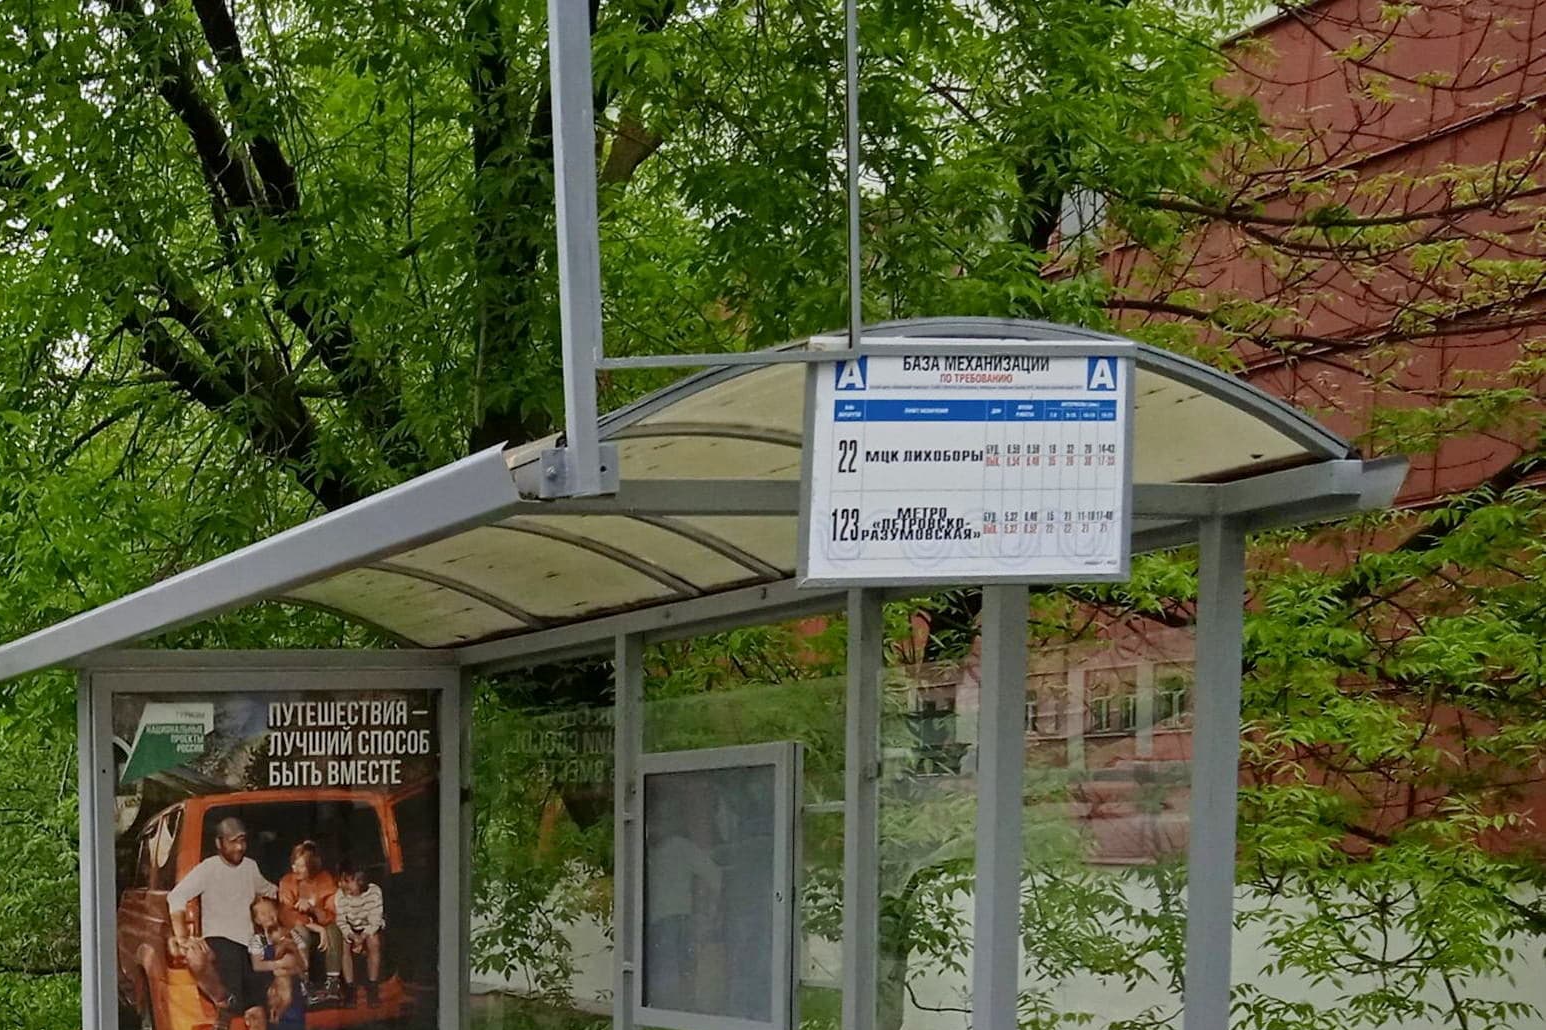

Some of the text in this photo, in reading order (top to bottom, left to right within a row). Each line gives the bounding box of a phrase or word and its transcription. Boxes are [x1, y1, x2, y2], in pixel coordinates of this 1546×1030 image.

[903, 355, 1050, 374] БАЗА МЕХАНИЗАЦИИ
[940, 373, 1013, 384] ПО ТРЕБОВАНИЮ
[838, 439, 858, 473] 22
[865, 450, 984, 463] МЦК ЛИХОБОРЫ
[831, 508, 860, 541] 123
[897, 507, 948, 520] МЕТРО
[861, 527, 982, 541] РАЗУМОВСКАЯ»
[268, 701, 408, 727] ПУТЕШЕСТВИЯ
[268, 726, 431, 757] ЛУЧШИЙ СПОСОБ
[268, 759, 403, 787] БЫТЬ ВМЕСТЕ
